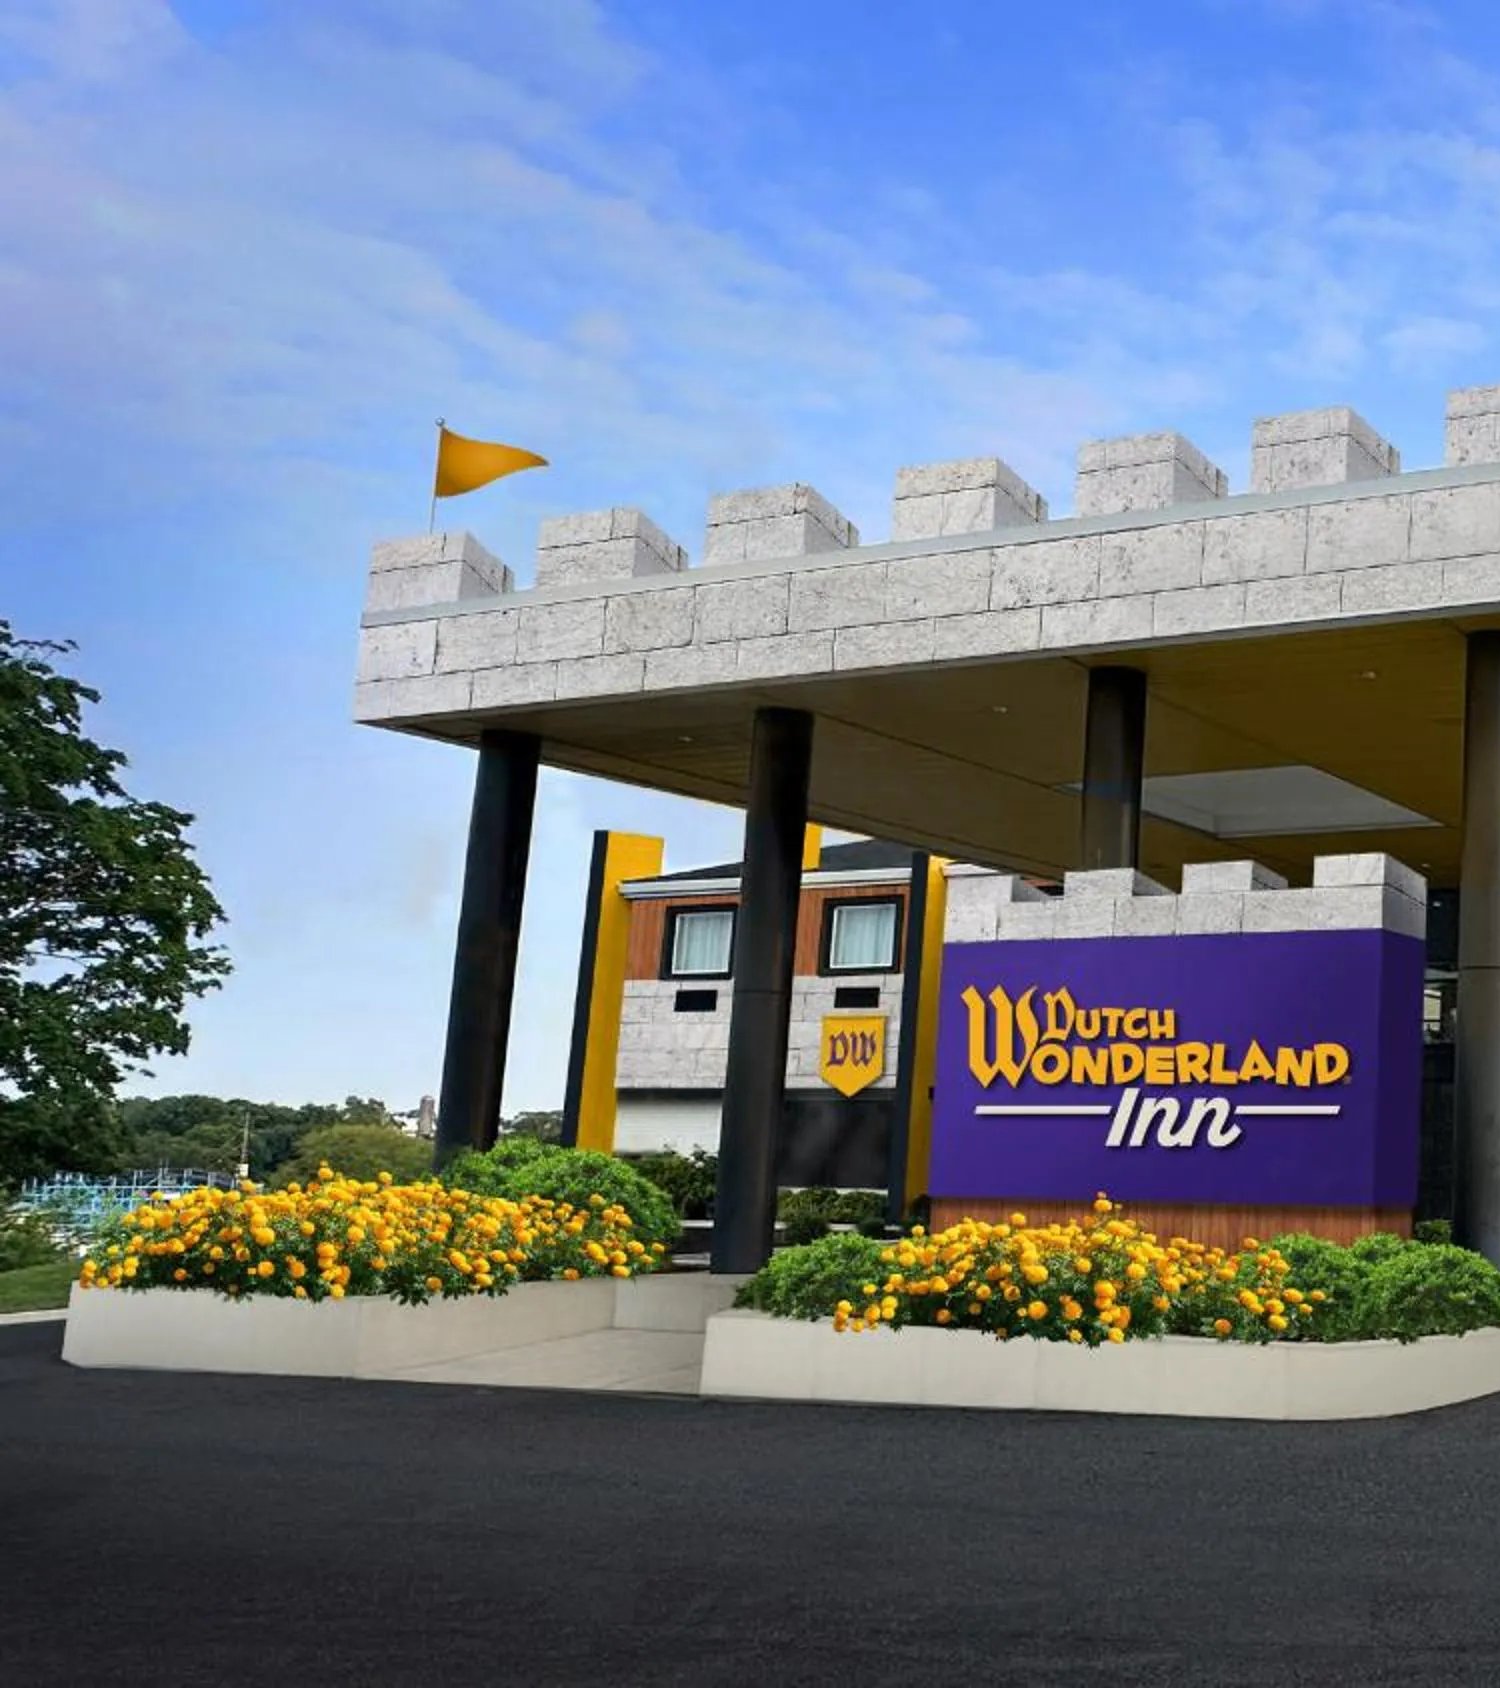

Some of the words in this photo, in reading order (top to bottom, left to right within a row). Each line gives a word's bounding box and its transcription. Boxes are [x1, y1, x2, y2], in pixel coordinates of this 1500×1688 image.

[961, 985, 1350, 1088] WONDERLAND
[1042, 986, 1175, 1042] DUTCH
[826, 1030, 877, 1068] DW
[1105, 1087, 1242, 1147] Inn
